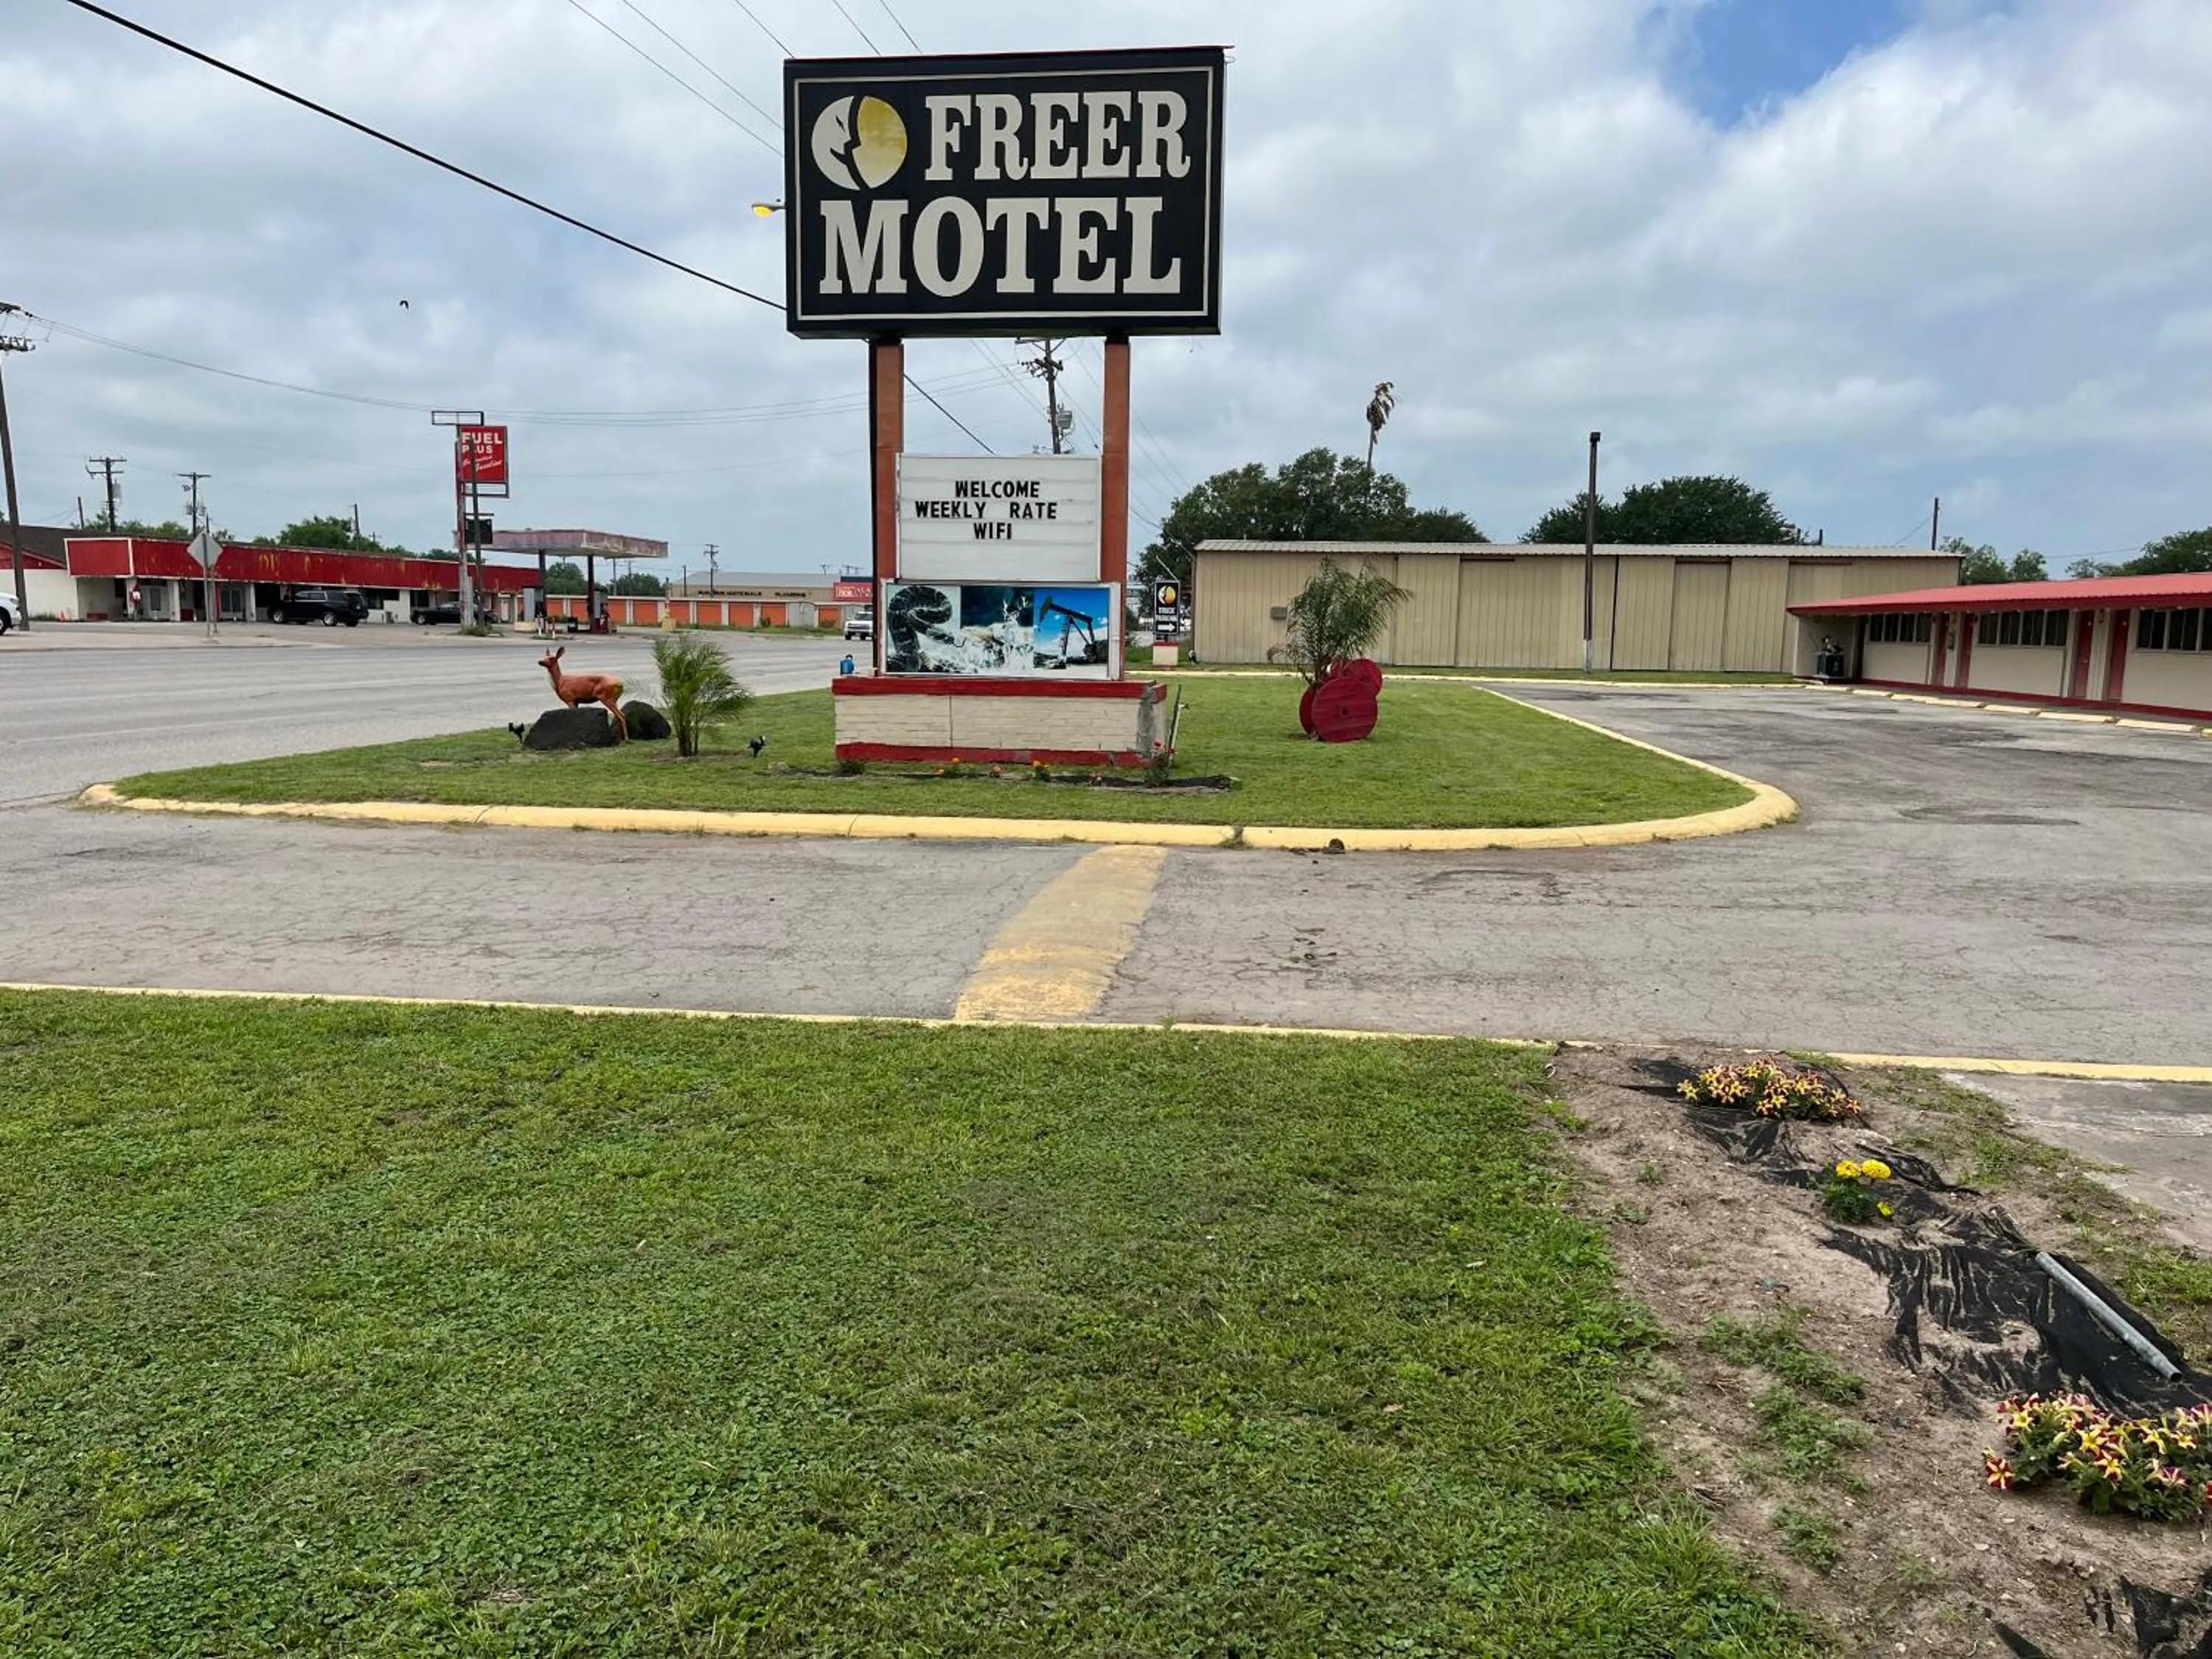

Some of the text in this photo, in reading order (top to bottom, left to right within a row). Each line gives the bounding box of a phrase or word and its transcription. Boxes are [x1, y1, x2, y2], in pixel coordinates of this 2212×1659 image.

[925, 90, 1192, 181] FREER
[819, 195, 1180, 297] MOTEL
[462, 432, 503, 445] FUEL
[462, 445, 493, 453] PUS
[955, 481, 1040, 498] WELCOME
[915, 501, 1057, 519] WEEKLY RATE
[973, 522, 1012, 540] WIFI
